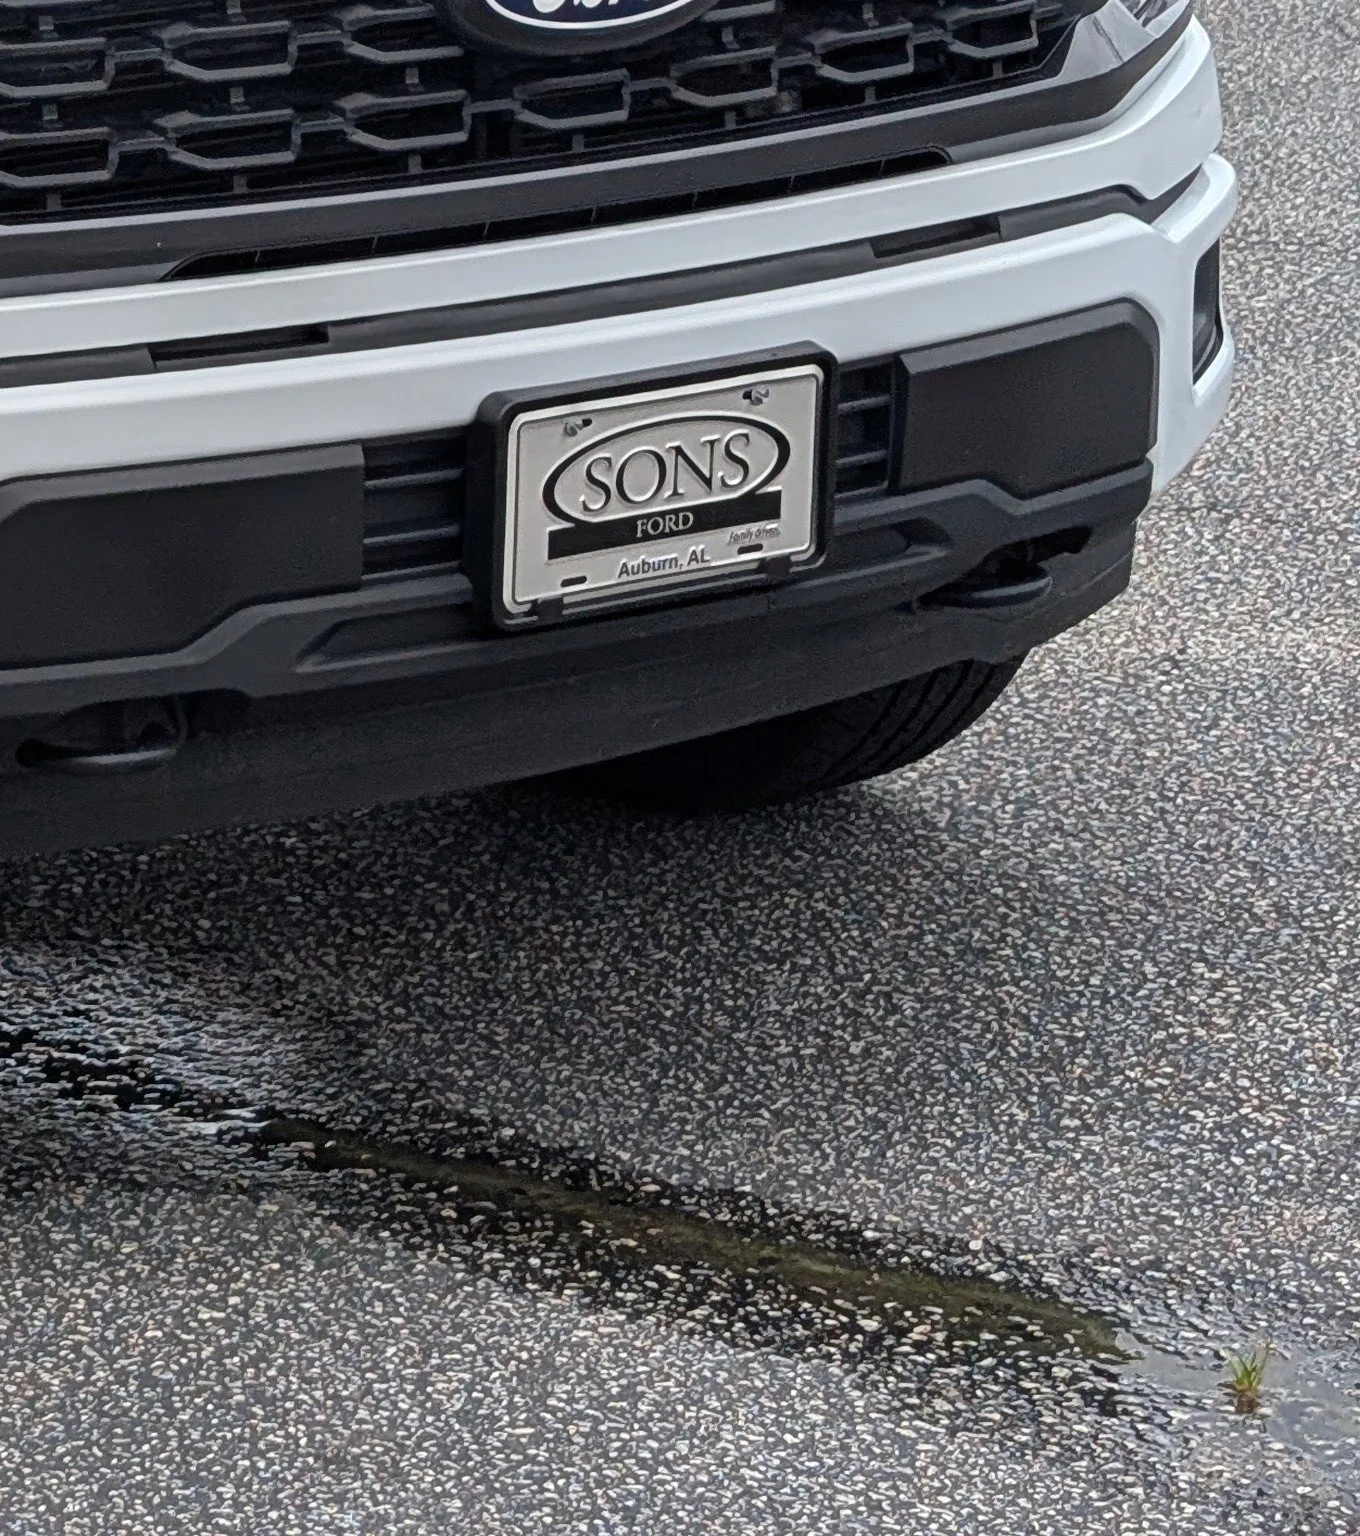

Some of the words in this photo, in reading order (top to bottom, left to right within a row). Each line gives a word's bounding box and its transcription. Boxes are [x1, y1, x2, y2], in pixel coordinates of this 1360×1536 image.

[578, 428, 751, 512] SONS
[636, 513, 694, 538] FORD
[617, 556, 682, 578] Auburn,
[686, 544, 712, 566] AL
